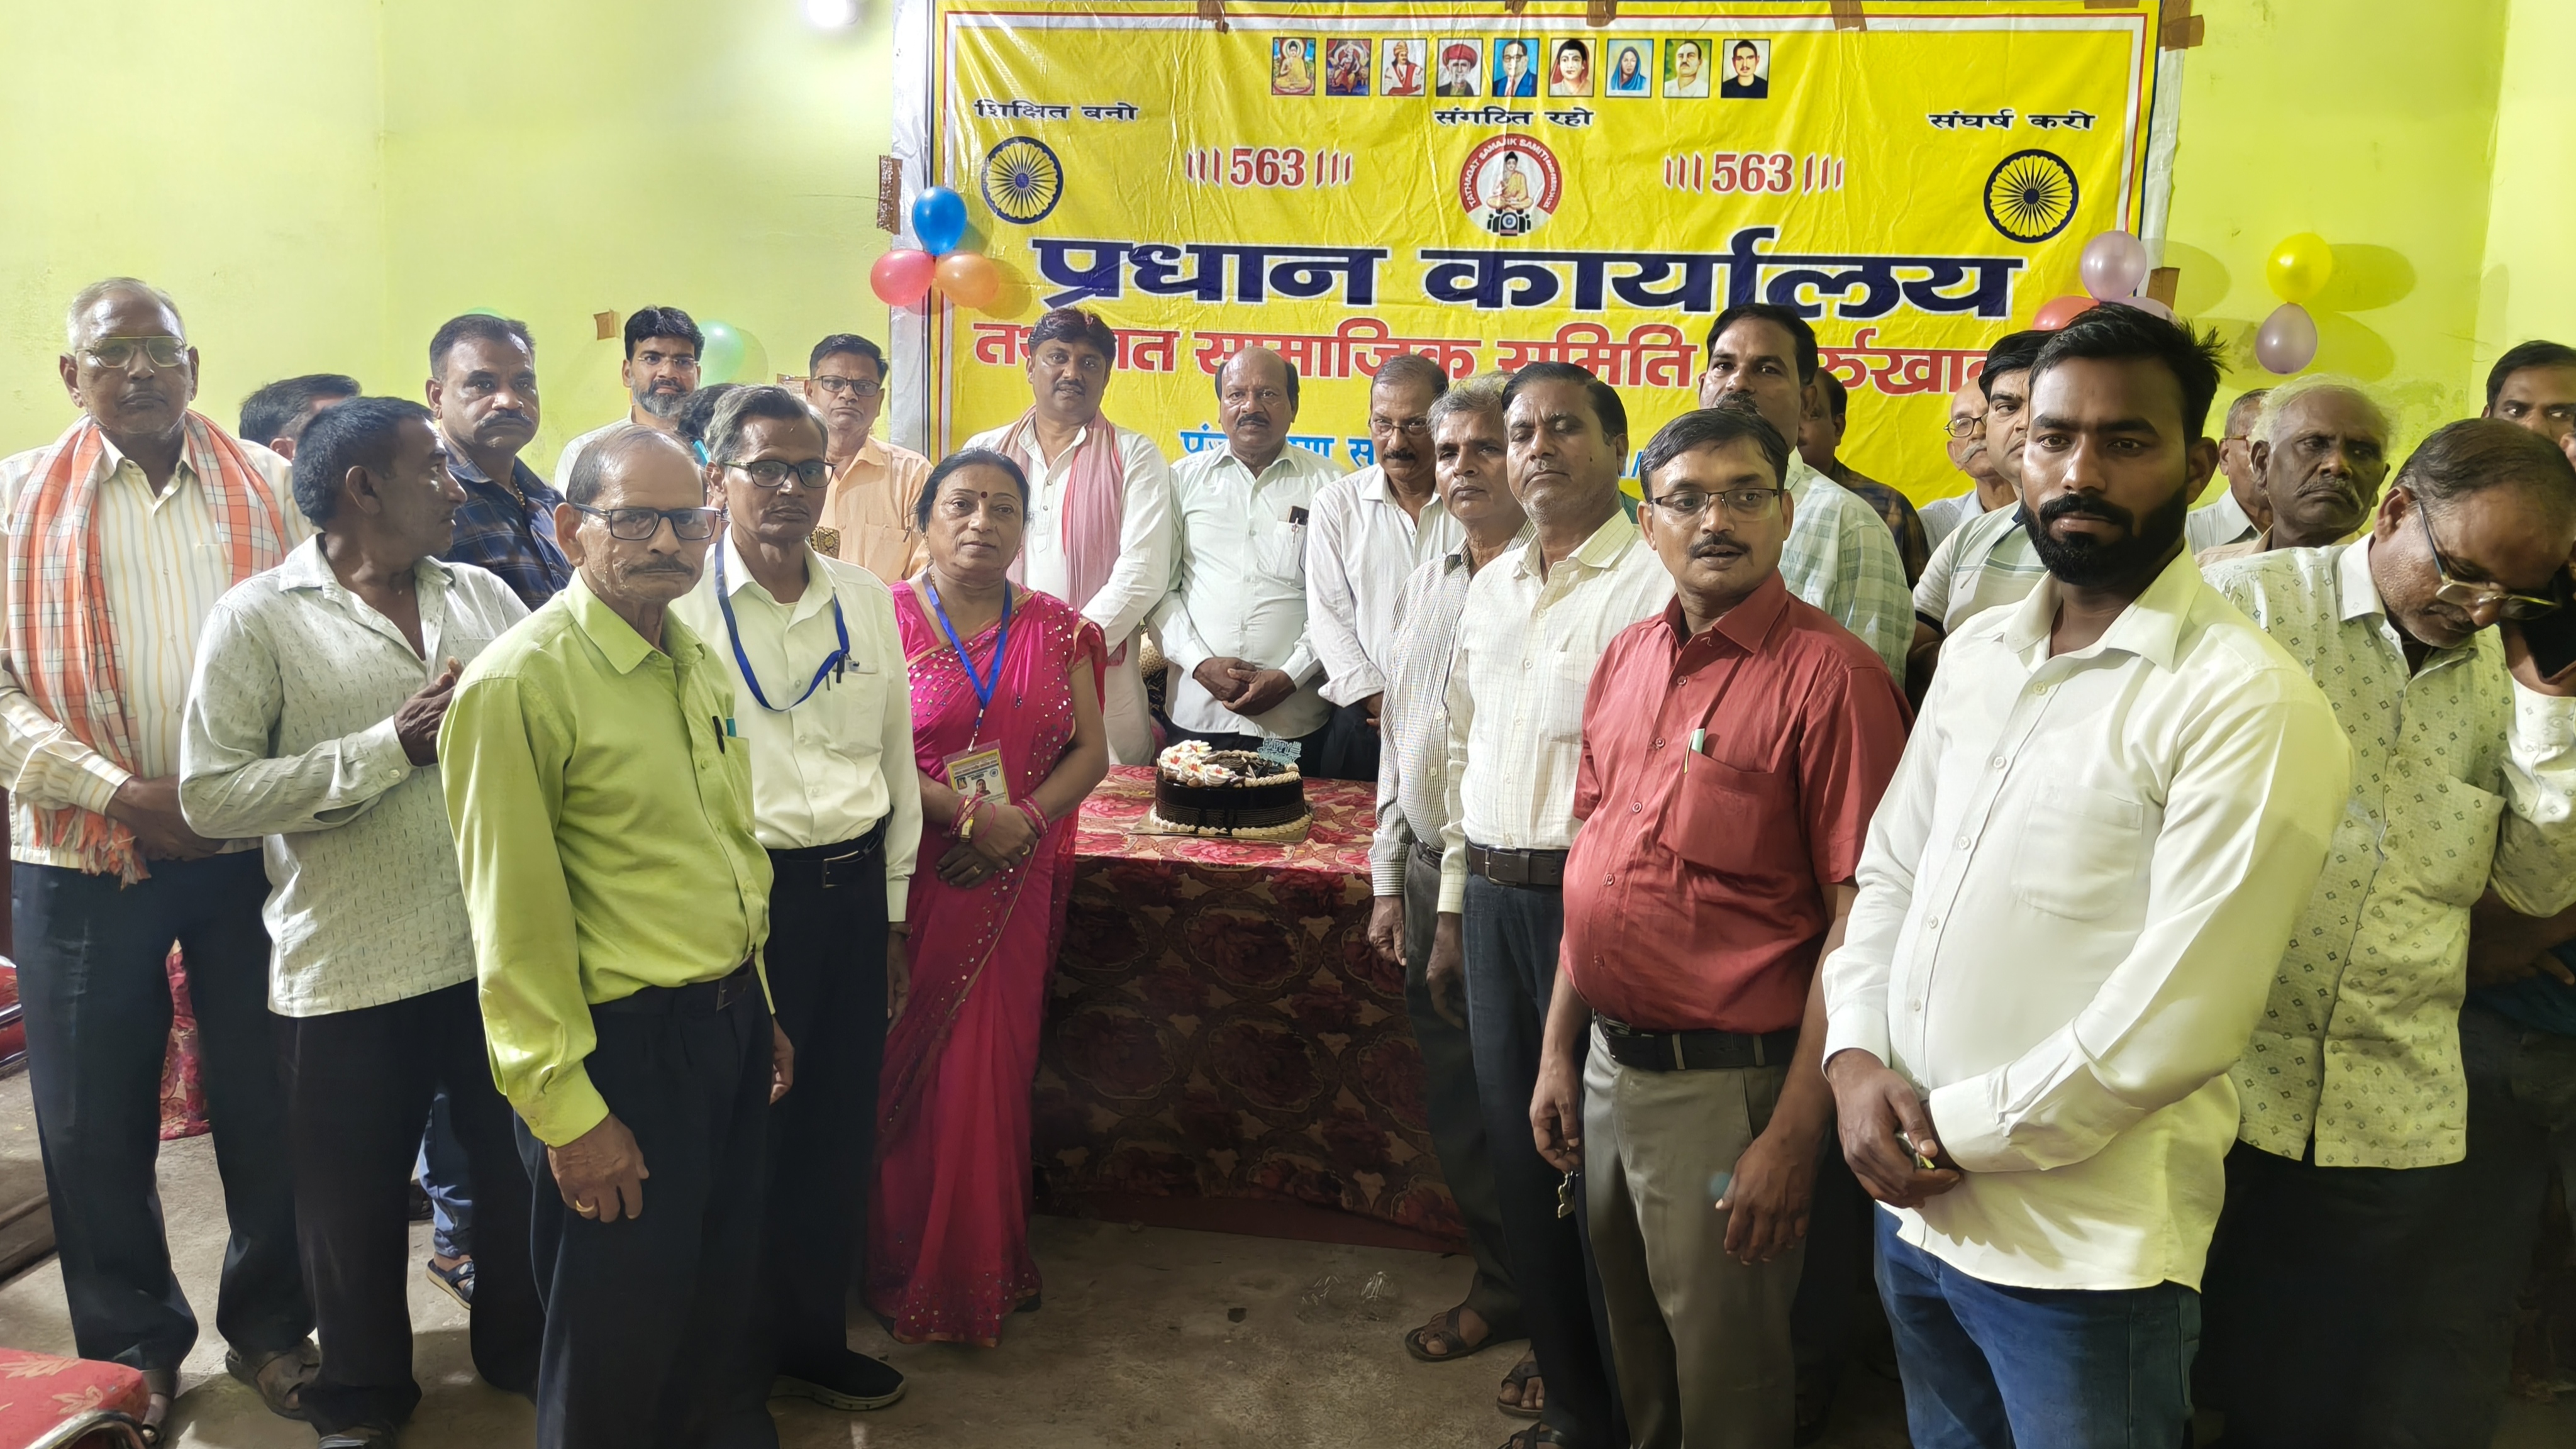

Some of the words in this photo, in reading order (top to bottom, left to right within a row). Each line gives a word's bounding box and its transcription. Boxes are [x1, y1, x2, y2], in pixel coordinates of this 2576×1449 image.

[974, 99, 1071, 118] शिक्षित
[1081, 102, 1139, 120] बनो
[1435, 106, 1534, 125] संगठित
[1544, 107, 1594, 126] रहो
[1928, 109, 2014, 128] संघर्ष
[2028, 109, 2096, 129] करो
[1032, 238, 1388, 308] प्रधान
[1421, 226, 2024, 319] कार्यालय
